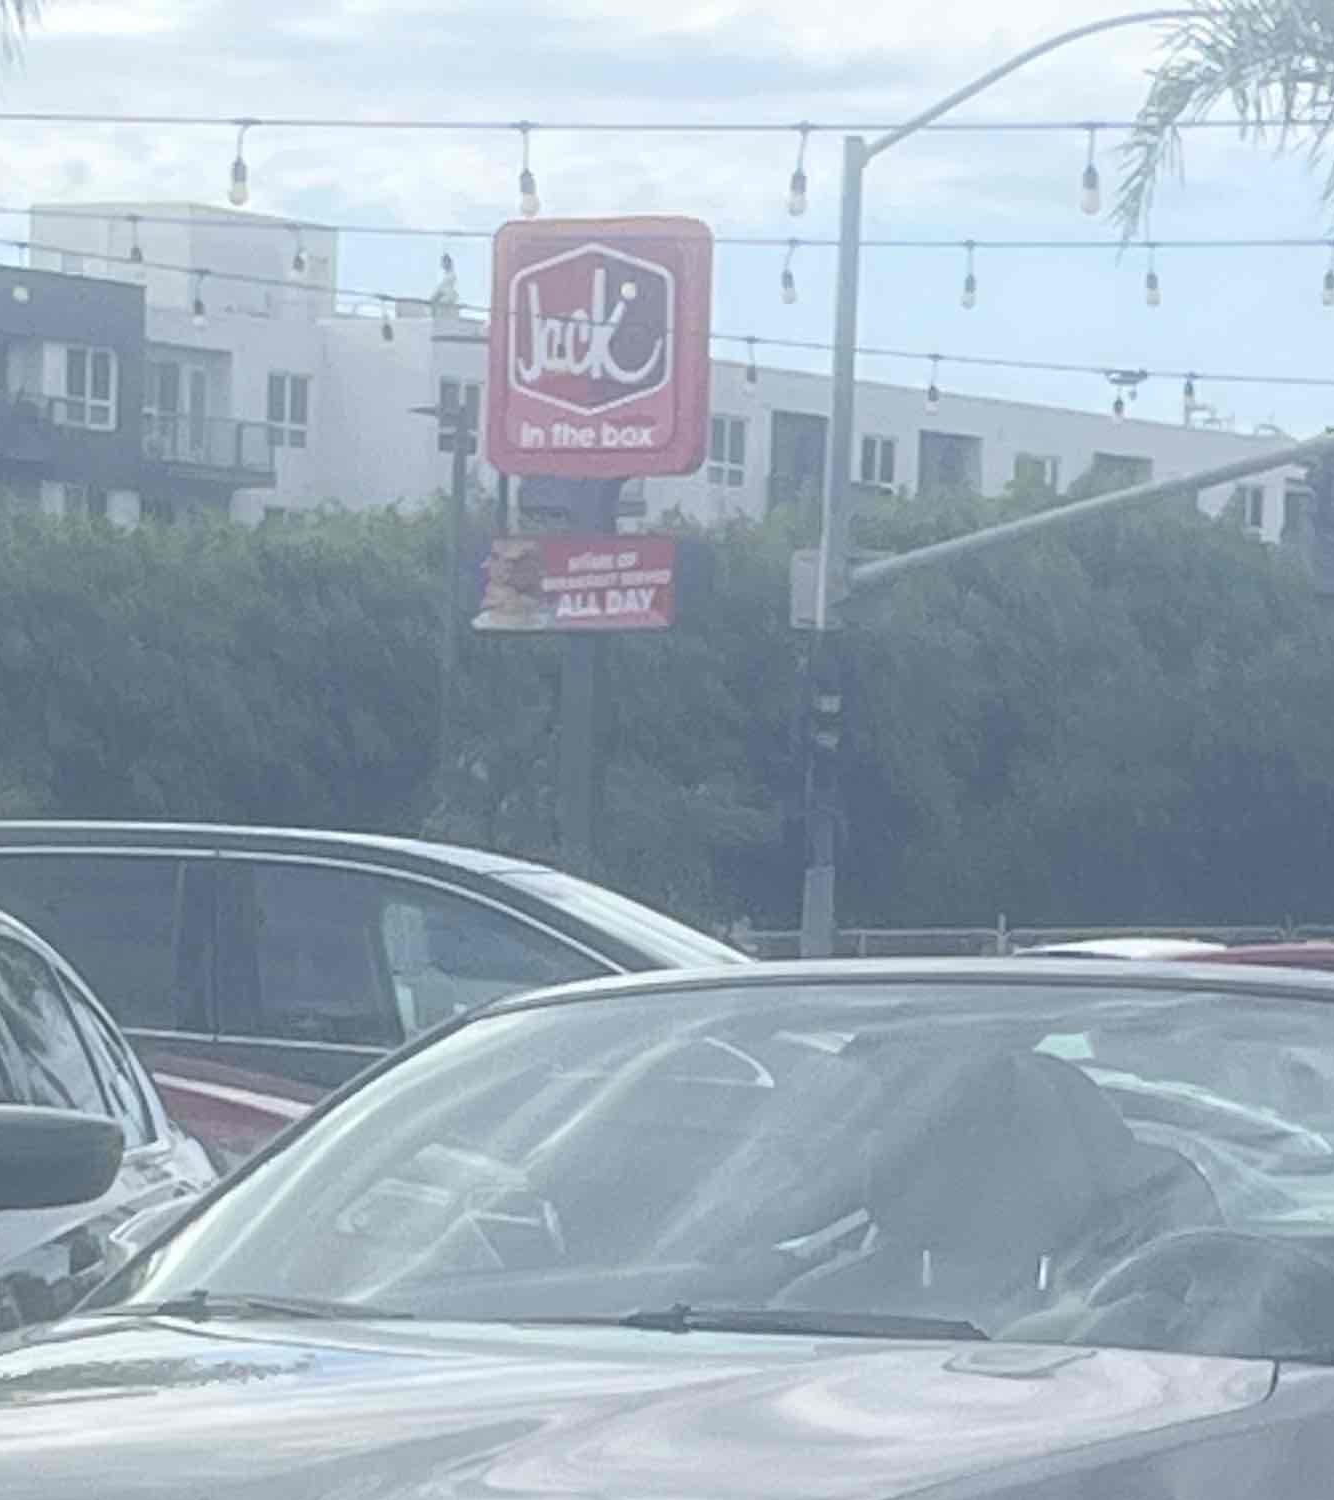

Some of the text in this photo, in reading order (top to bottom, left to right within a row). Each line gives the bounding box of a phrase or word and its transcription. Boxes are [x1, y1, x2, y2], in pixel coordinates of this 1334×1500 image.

[518, 268, 663, 384] Jack
[551, 421, 596, 448] the
[602, 421, 653, 448] box
[556, 588, 658, 617] ALL DAY
